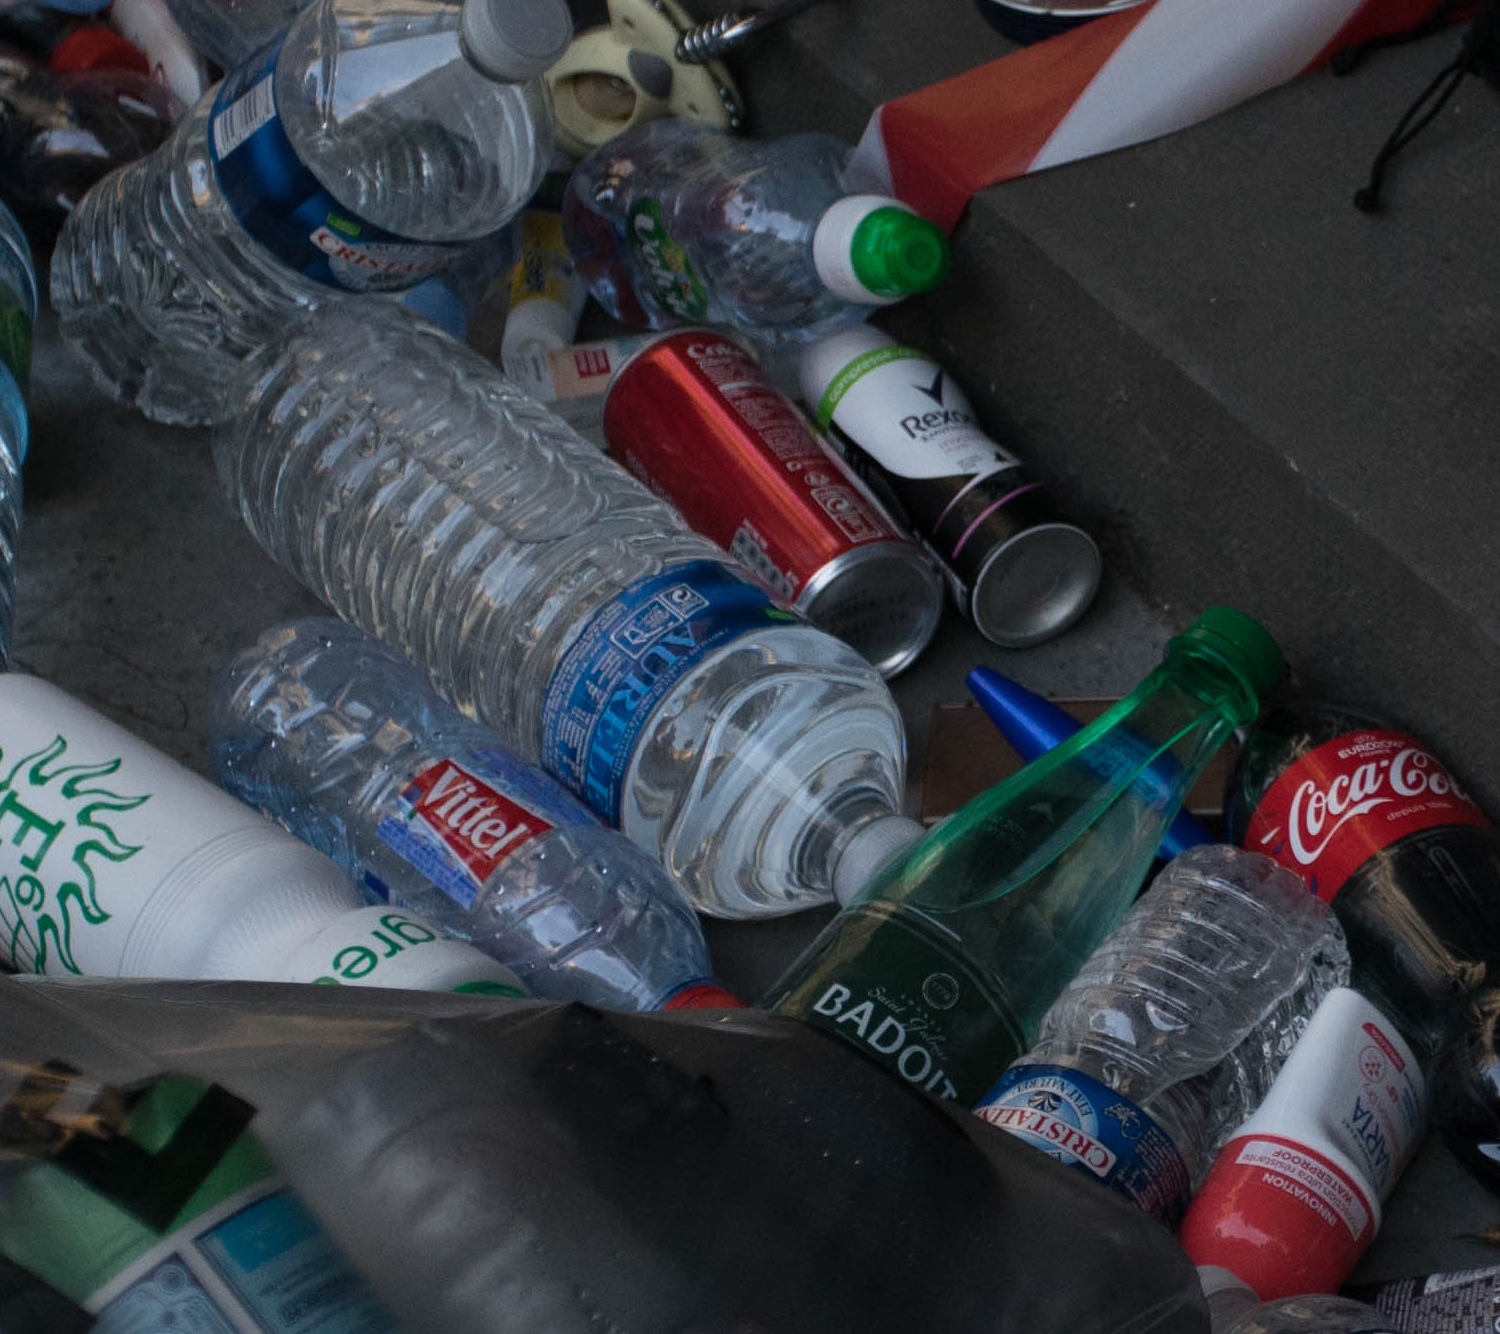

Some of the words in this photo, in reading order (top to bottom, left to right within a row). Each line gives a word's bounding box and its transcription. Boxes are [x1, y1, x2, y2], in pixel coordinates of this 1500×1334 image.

[415, 765, 532, 860] Vittel
[312, 912, 439, 985] gre
[812, 982, 959, 1101] BADOIT
[976, 1107, 1111, 1169] CRISTALIN
[1262, 1172, 1338, 1228] INNOVATION
[1272, 1148, 1355, 1204] WATERPROOF
